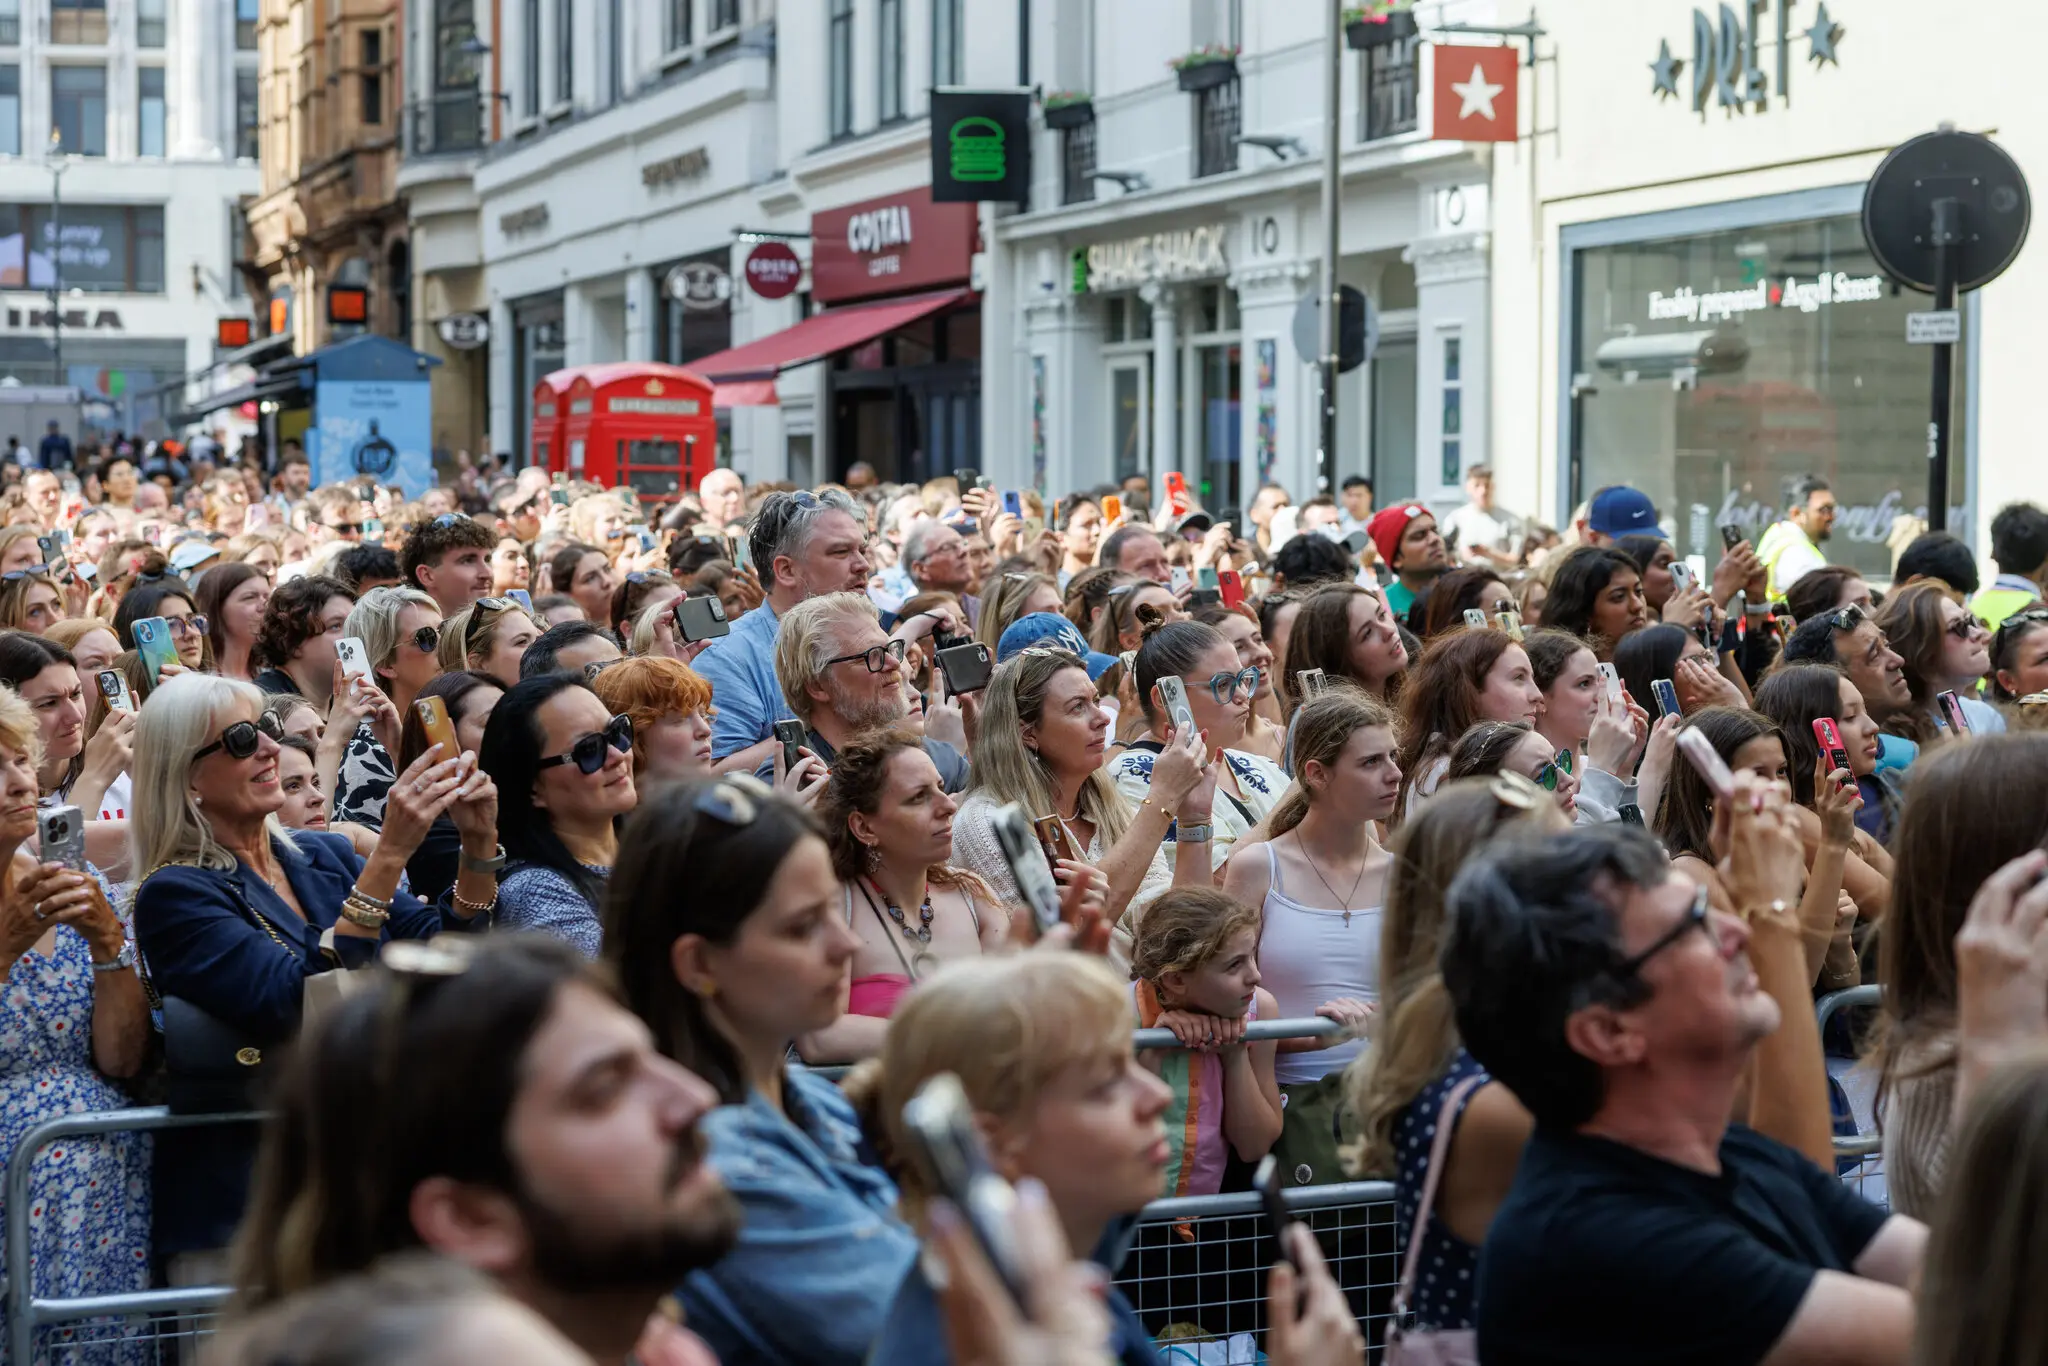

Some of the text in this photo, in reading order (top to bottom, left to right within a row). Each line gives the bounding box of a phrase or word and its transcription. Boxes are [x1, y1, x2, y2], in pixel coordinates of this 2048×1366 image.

[1434, 184, 1466, 230] 10
[1087, 223, 1228, 289] SHAKE SHACK
[1253, 216, 1279, 256] 10
[749, 258, 798, 274] COSTA
[8, 309, 124, 328] IKEA
